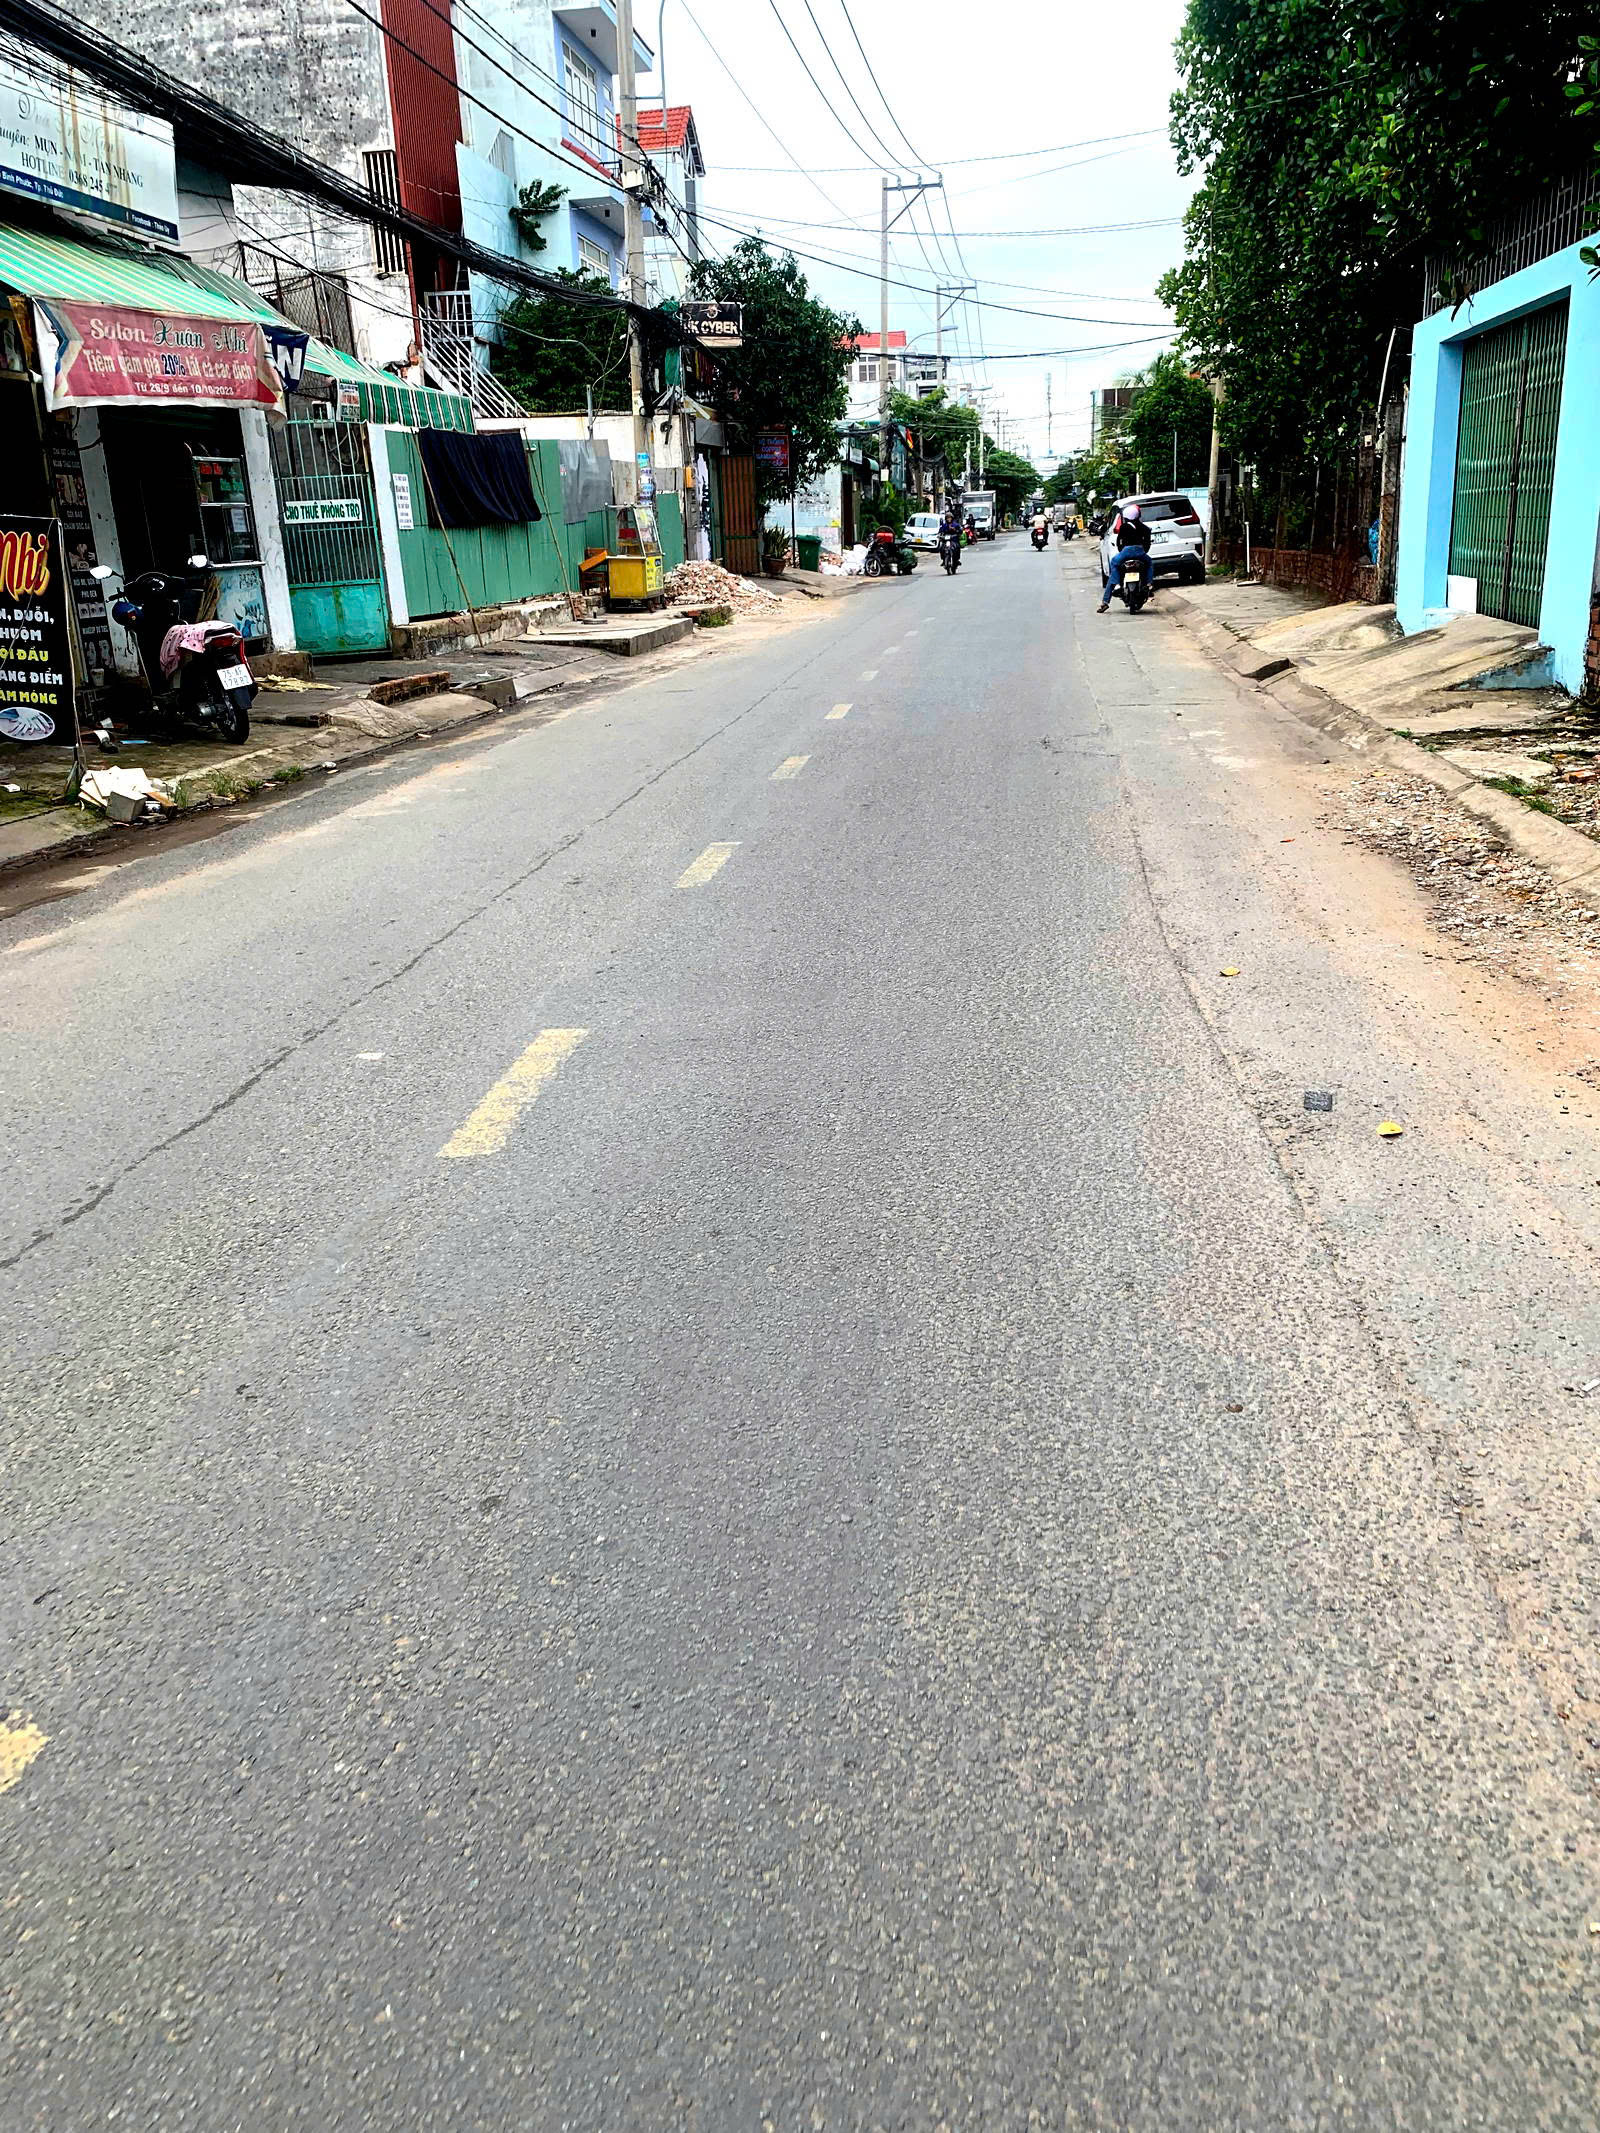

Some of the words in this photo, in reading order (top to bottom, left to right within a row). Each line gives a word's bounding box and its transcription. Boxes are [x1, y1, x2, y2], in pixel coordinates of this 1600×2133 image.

[89, 318, 149, 343] Salon
[153, 318, 206, 350] Xuân
[700, 320, 739, 335] CYBER
[83, 349, 116, 377] Tiệm
[143, 353, 161, 379] giá
[160, 353, 187, 377] 20%
[284, 503, 300, 521] CHO
[299, 501, 320, 520] THUÊ
[320, 500, 346, 519] PHÒNG
[346, 502, 361, 520] TRỌ
[29, 667, 64, 686] ĐIỂM
